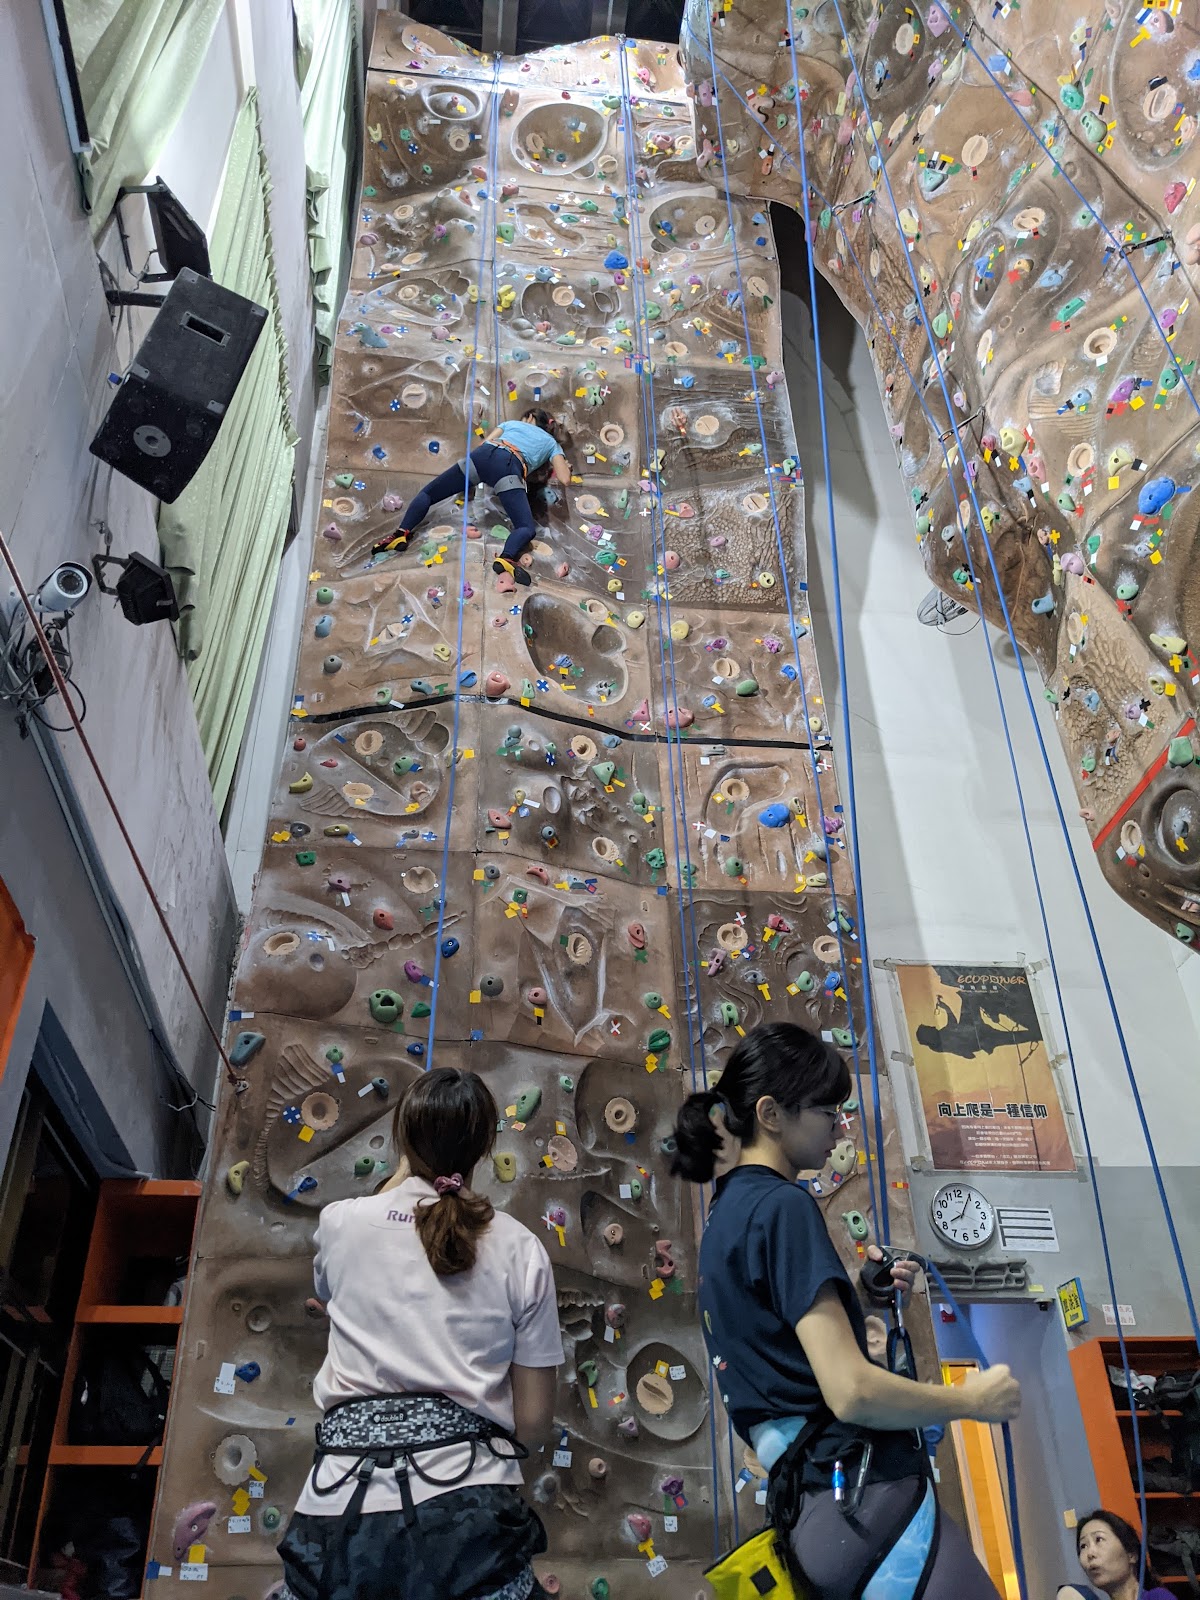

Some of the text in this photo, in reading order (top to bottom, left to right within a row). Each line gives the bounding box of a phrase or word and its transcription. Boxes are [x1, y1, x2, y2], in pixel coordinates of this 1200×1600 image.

[937, 1102, 1049, 1119] 向上爬是一種信仰
[945, 1192, 953, 1201] 11
[953, 1189, 963, 1198] 12
[938, 1199, 948, 1209] 10
[974, 1200, 982, 1210] 2
[936, 1210, 943, 1219] 9
[980, 1211, 987, 1220] 3
[942, 1221, 949, 1230] 8
[979, 1222, 986, 1231] 4
[951, 1228, 958, 1238] 7
[962, 1232, 969, 1242] 6
[973, 1229, 980, 1239] 5
